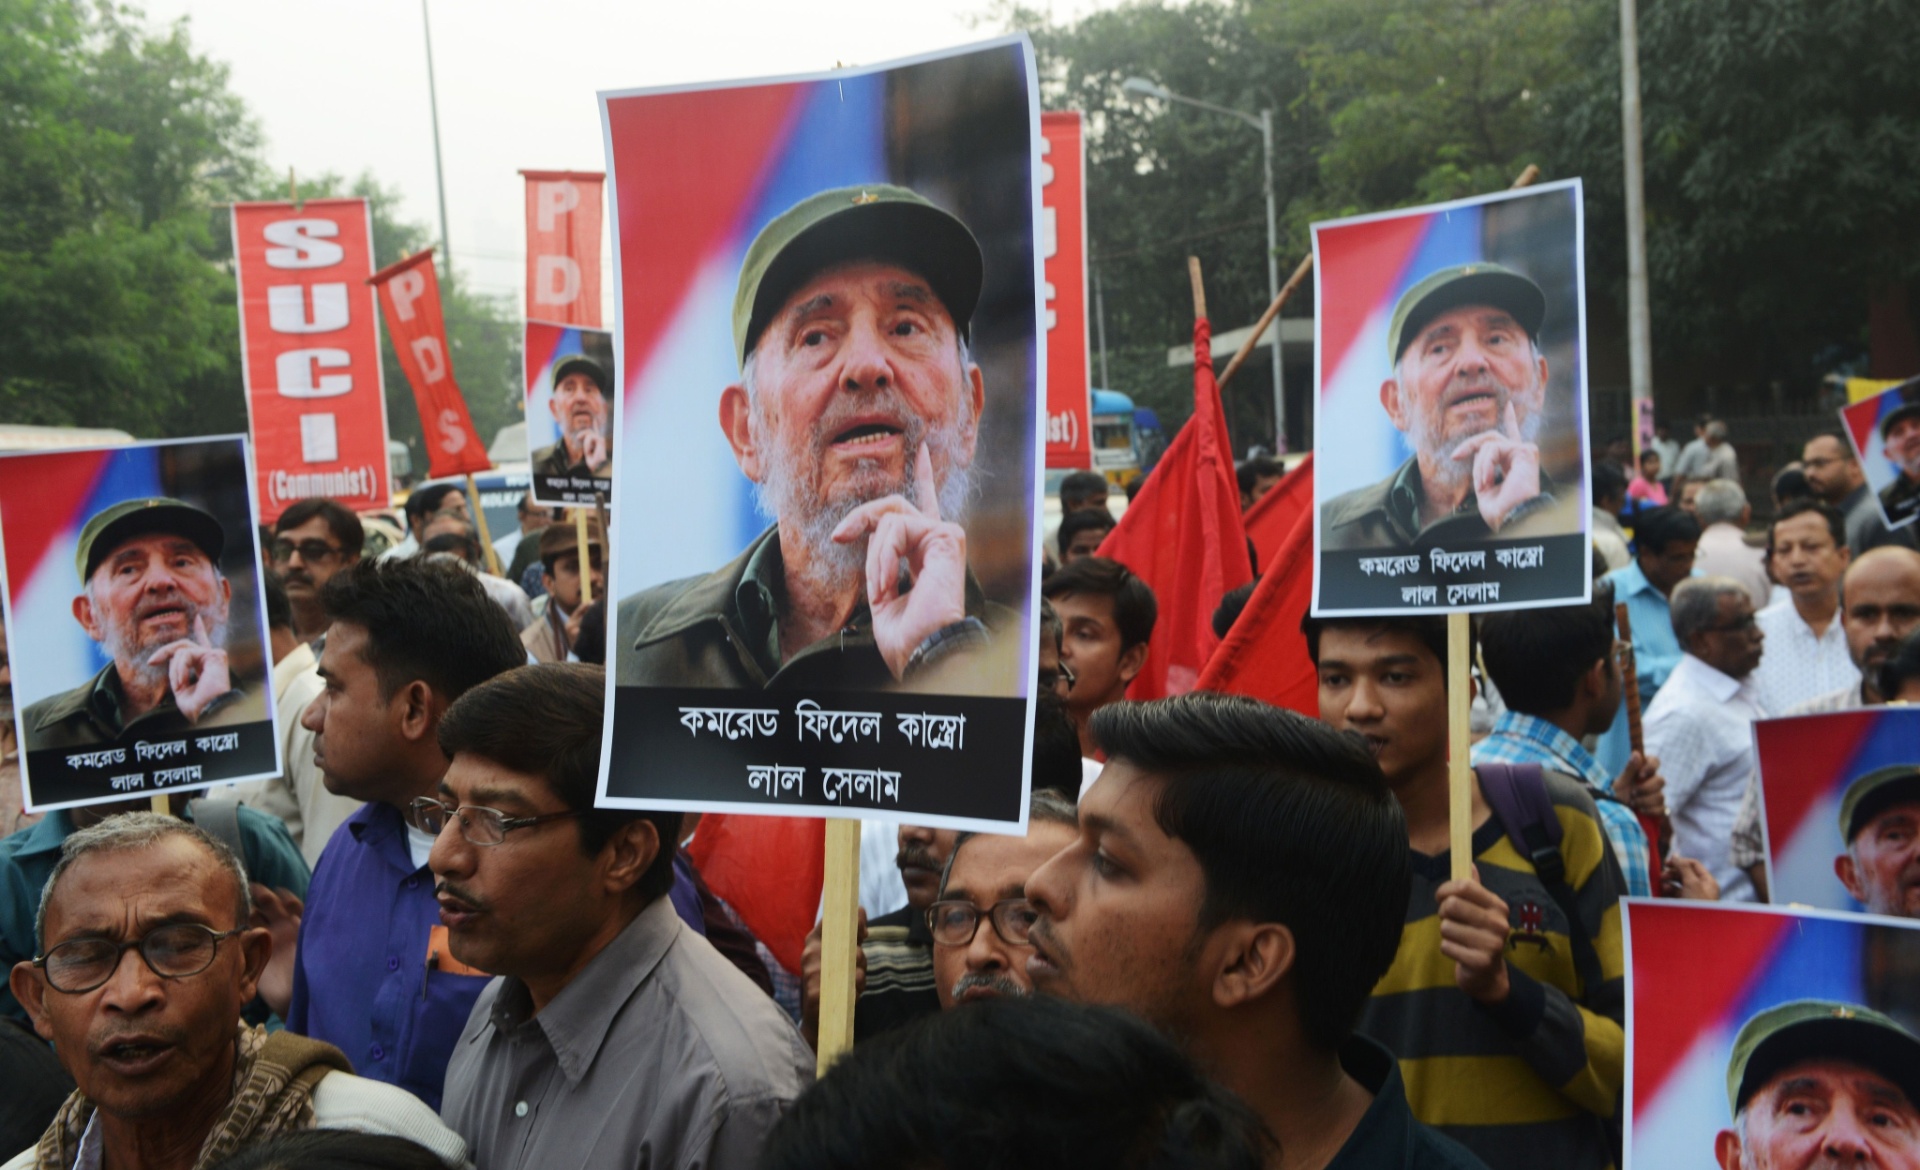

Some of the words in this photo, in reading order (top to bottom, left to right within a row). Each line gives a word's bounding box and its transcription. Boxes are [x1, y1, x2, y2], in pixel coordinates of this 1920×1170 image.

[263, 218, 352, 463] SUCI
[388, 269, 467, 454] PDS
[268, 464, 377, 508] (Communist)
[1359, 555, 1420, 576] কমরেড
[1430, 548, 1485, 573] ফিদেল
[1401, 585, 1438, 605] লাল
[1446, 581, 1500, 605] সেলাম
[679, 707, 779, 740] কমরেড
[795, 699, 882, 743] ফিদেল
[896, 711, 967, 750] কাস্ত্রো
[66, 748, 126, 770] কমরেড
[135, 740, 187, 762] ফিদেল
[110, 772, 145, 791] লাল
[153, 764, 203, 787] সেলাম
[747, 763, 806, 798] লাল
[821, 767, 901, 803] সেলাম
